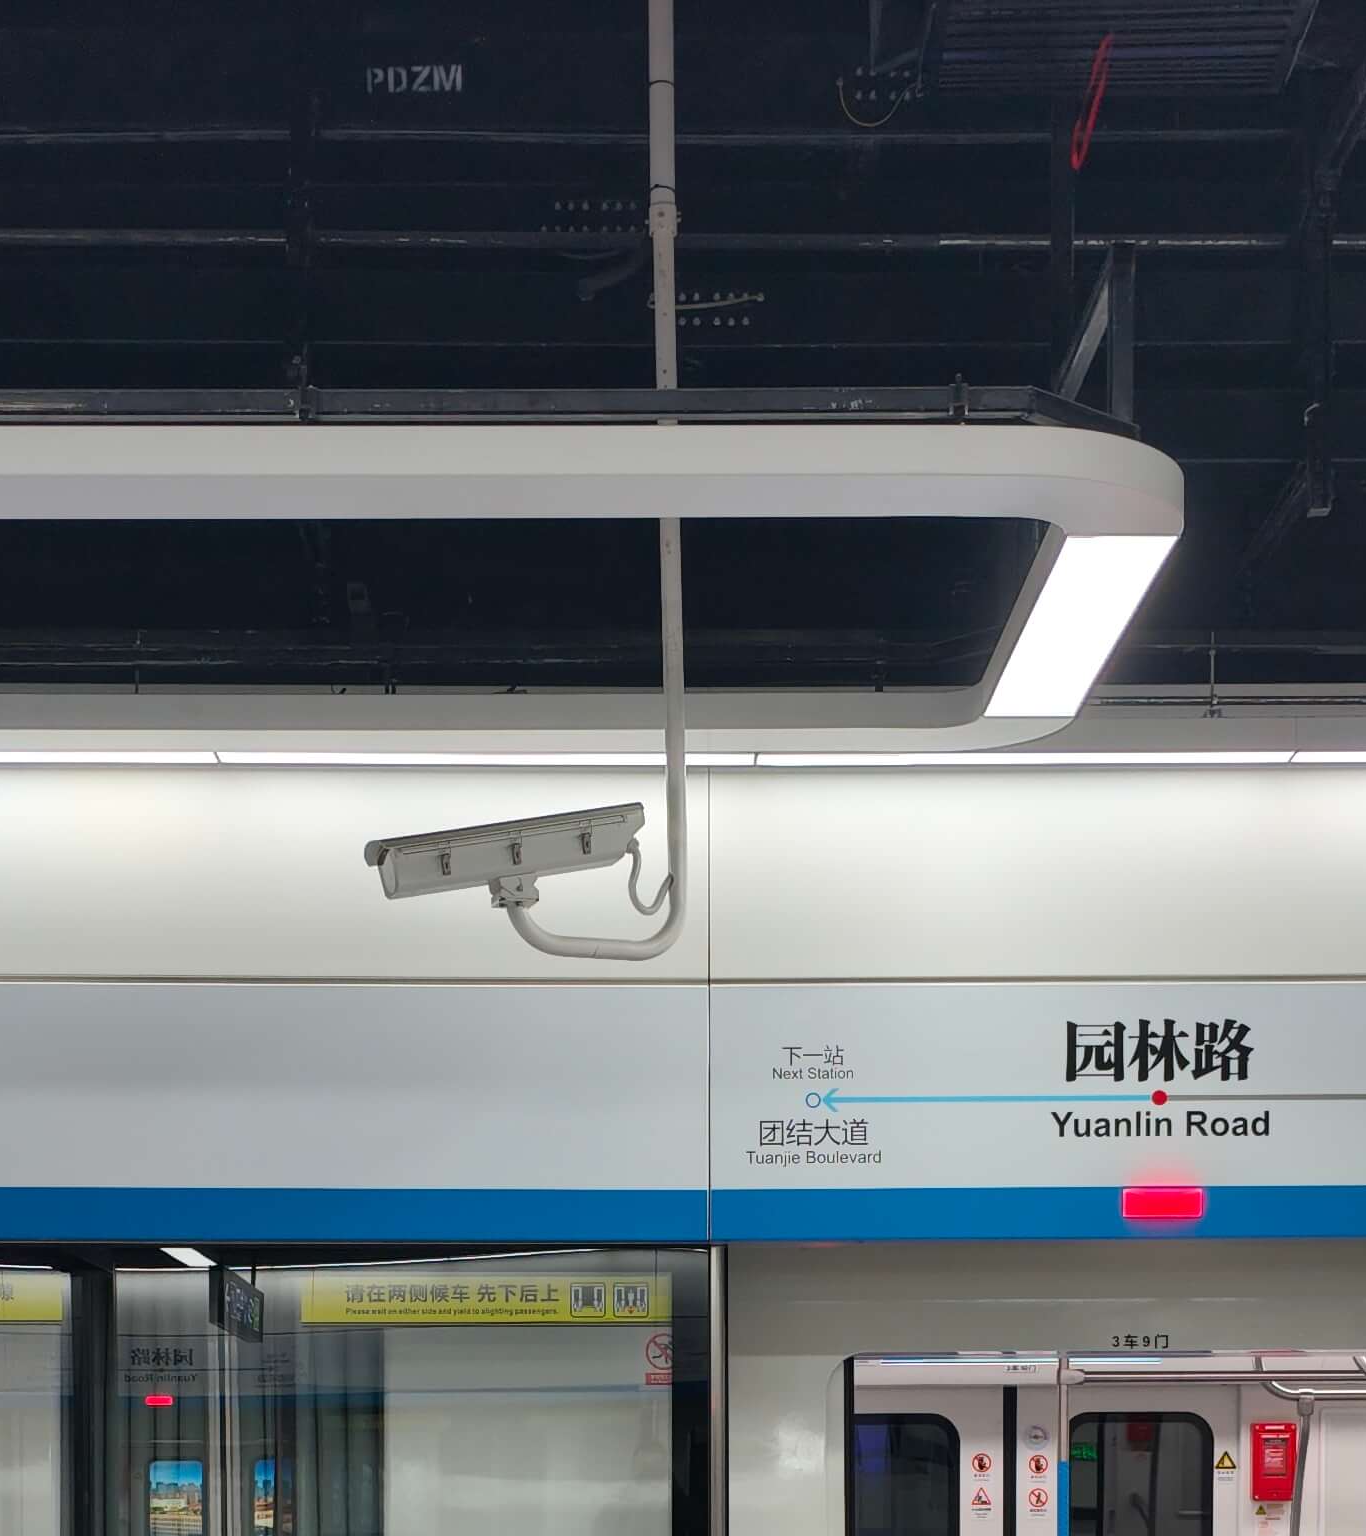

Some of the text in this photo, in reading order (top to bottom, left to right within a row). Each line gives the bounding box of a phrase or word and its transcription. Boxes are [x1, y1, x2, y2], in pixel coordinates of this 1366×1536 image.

[366, 64, 463, 93] PDZM
[782, 1045, 844, 1067] 下一站
[1065, 1018, 1255, 1082] 园林路
[772, 1066, 854, 1079] Next Station
[759, 1118, 869, 1147] 团结大道
[1051, 1110, 1270, 1138] Yuanlin Road
[746, 1150, 882, 1168] Tuanjie Boulevard
[345, 1284, 560, 1303] 请在两侧候车 先下后上
